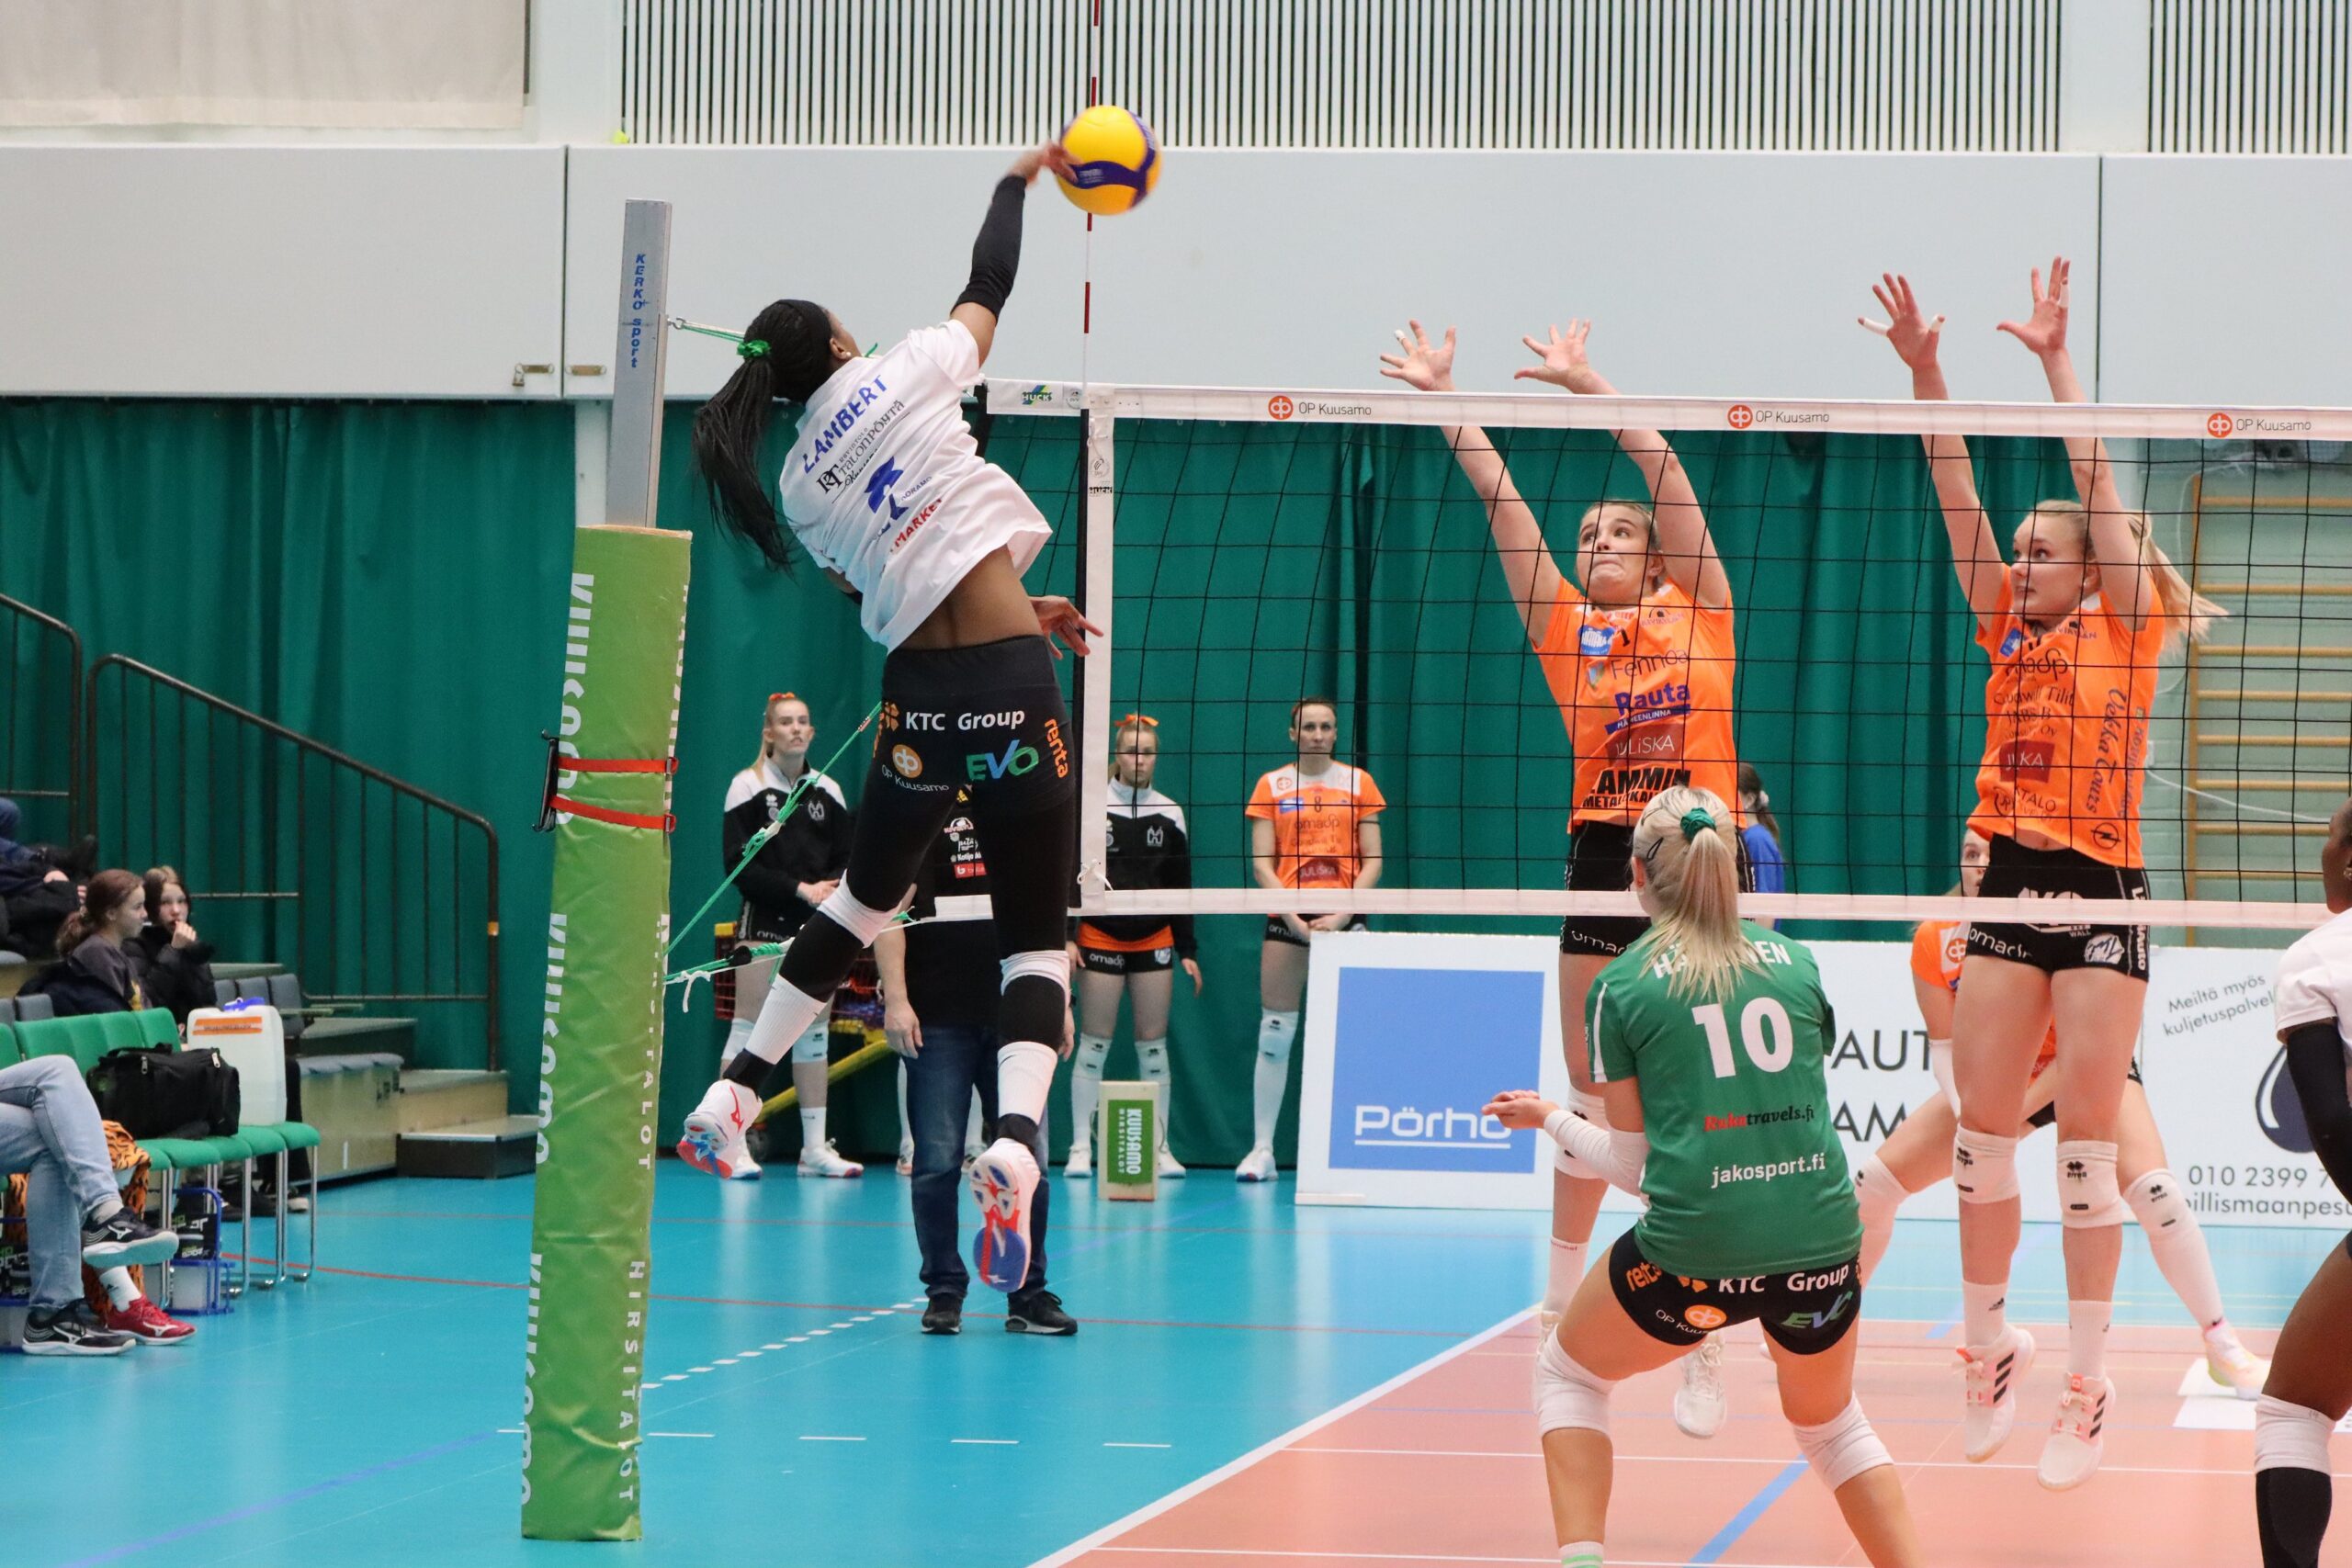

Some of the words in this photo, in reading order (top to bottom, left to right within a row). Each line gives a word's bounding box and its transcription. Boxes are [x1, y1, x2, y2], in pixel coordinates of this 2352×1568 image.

[632, 254, 646, 310] KERKO
[631, 318, 641, 368] sport
[803, 375, 888, 474] LAMBERT
[1298, 401, 1316, 414] OP
[1318, 403, 1372, 415] Kuusamo
[1755, 410, 1773, 423] OP
[1775, 411, 1830, 423] Kuusamo
[2235, 418, 2254, 431] OP
[2256, 419, 2312, 431] Kuusamo
[1611, 649, 1690, 680] Fennoa
[1614, 682, 1690, 716] Rauta
[906, 711, 946, 731] KTC
[957, 710, 1025, 730] Group
[966, 739, 1039, 781] EVO
[1044, 717, 1069, 779] renta
[881, 763, 893, 779] OP
[895, 774, 950, 792] Kuusamo
[1590, 767, 1691, 795] AMMIN
[2168, 987, 2219, 1013] Meiltä
[2223, 974, 2267, 996] myös
[1690, 996, 1794, 1080] 10
[1126, 1108, 1142, 1175] KUUSAMO
[1711, 1152, 1826, 1190] jakosport.fi
[2188, 1165, 2235, 1187] 010
[2245, 1167, 2308, 1188] 2399
[1718, 1275, 1769, 1294] KTC
[1787, 1264, 1849, 1292] Group
[1655, 1309, 1675, 1325] OP
[618, 1260, 646, 1501] HIRSITAOT
